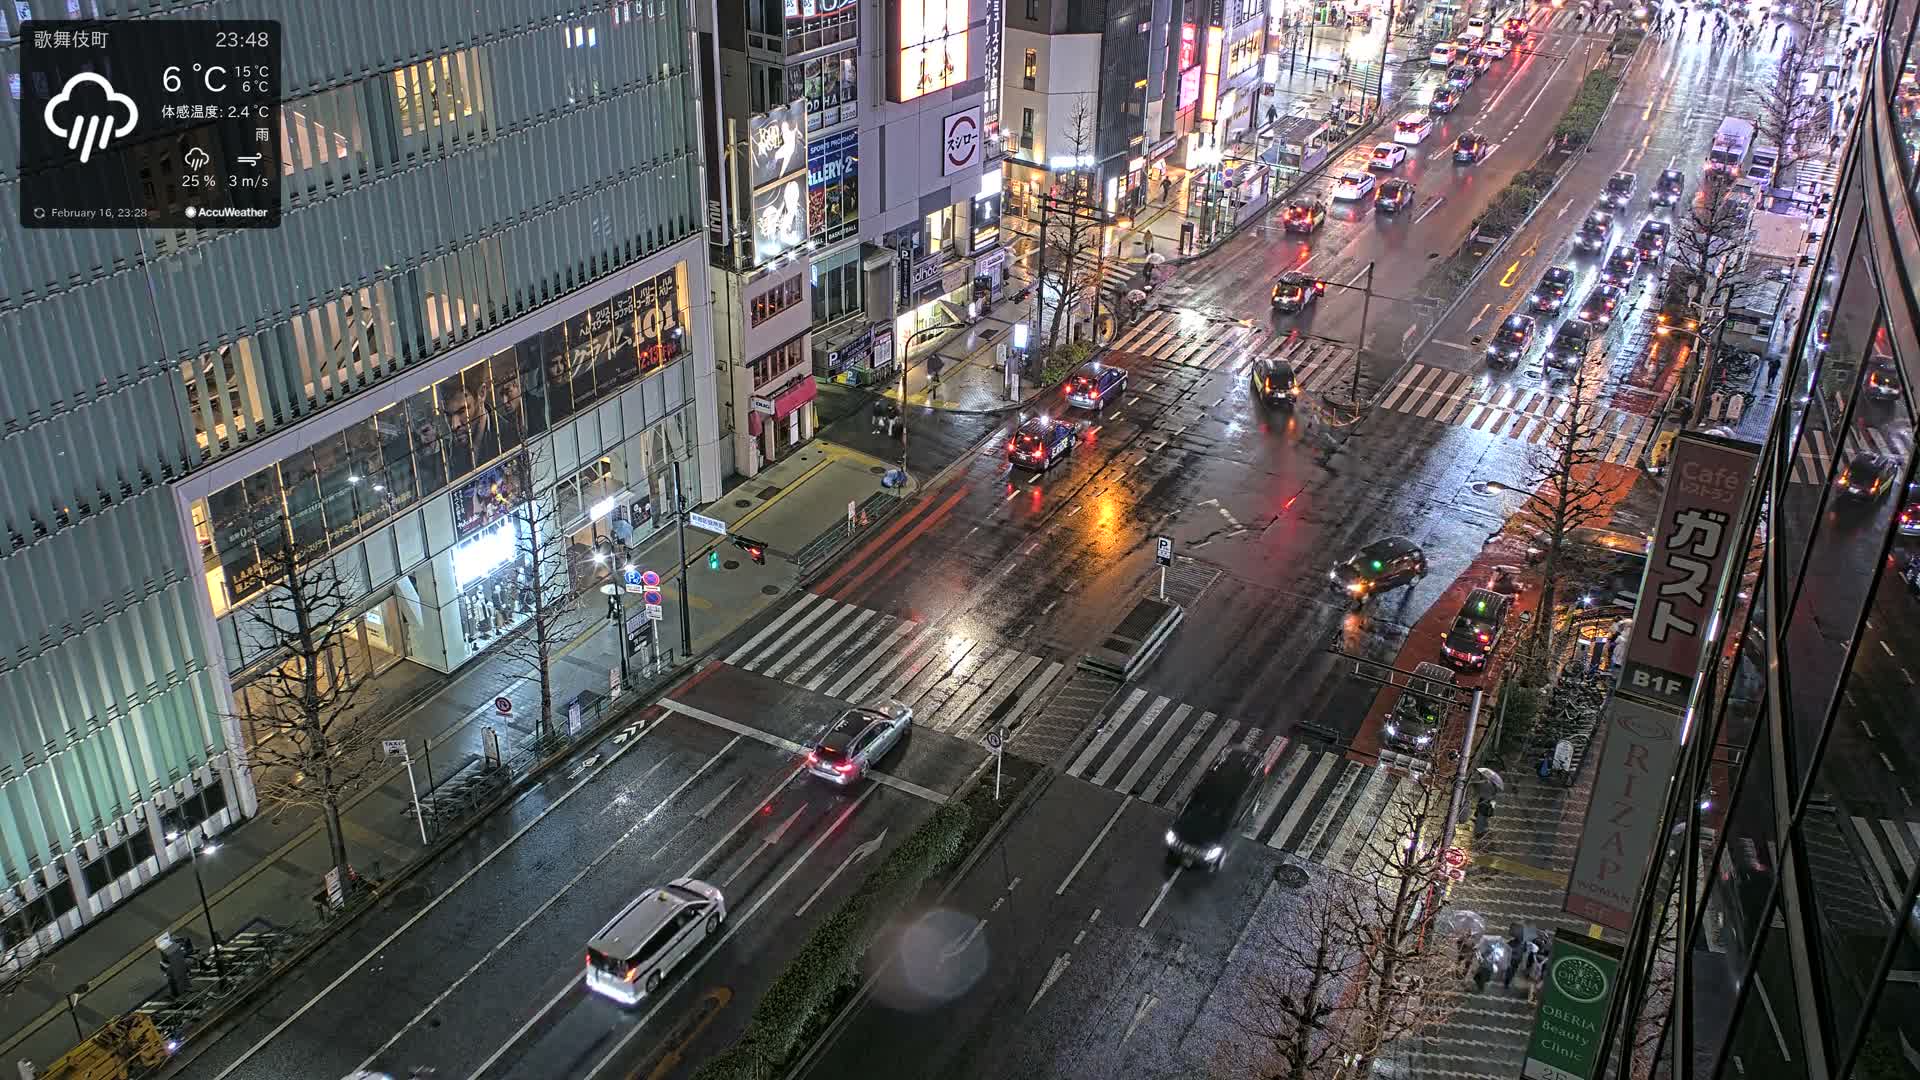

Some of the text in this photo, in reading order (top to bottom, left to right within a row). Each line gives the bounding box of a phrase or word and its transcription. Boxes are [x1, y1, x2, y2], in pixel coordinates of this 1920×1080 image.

[810, 141, 830, 154] SPORTS
[947, 134, 978, 152] スシロー
[708, 200, 722, 233] MUJI
[828, 225, 857, 240] BASKETBALL
[901, 250, 909, 259] P
[617, 295, 633, 308] マーク
[595, 307, 611, 320] クリス
[828, 352, 838, 367] P
[1681, 461, 1739, 490] Café
[1160, 540, 1168, 549] P
[628, 572, 635, 583] P
[1650, 510, 1728, 641] ガスト
[1632, 669, 1682, 695] B1F
[1600, 743, 1649, 881] RIZAP
[1542, 1004, 1596, 1033] OBERIA
[1542, 1020, 1589, 1047] Beauty
[1541, 1038, 1584, 1061] Clinic
